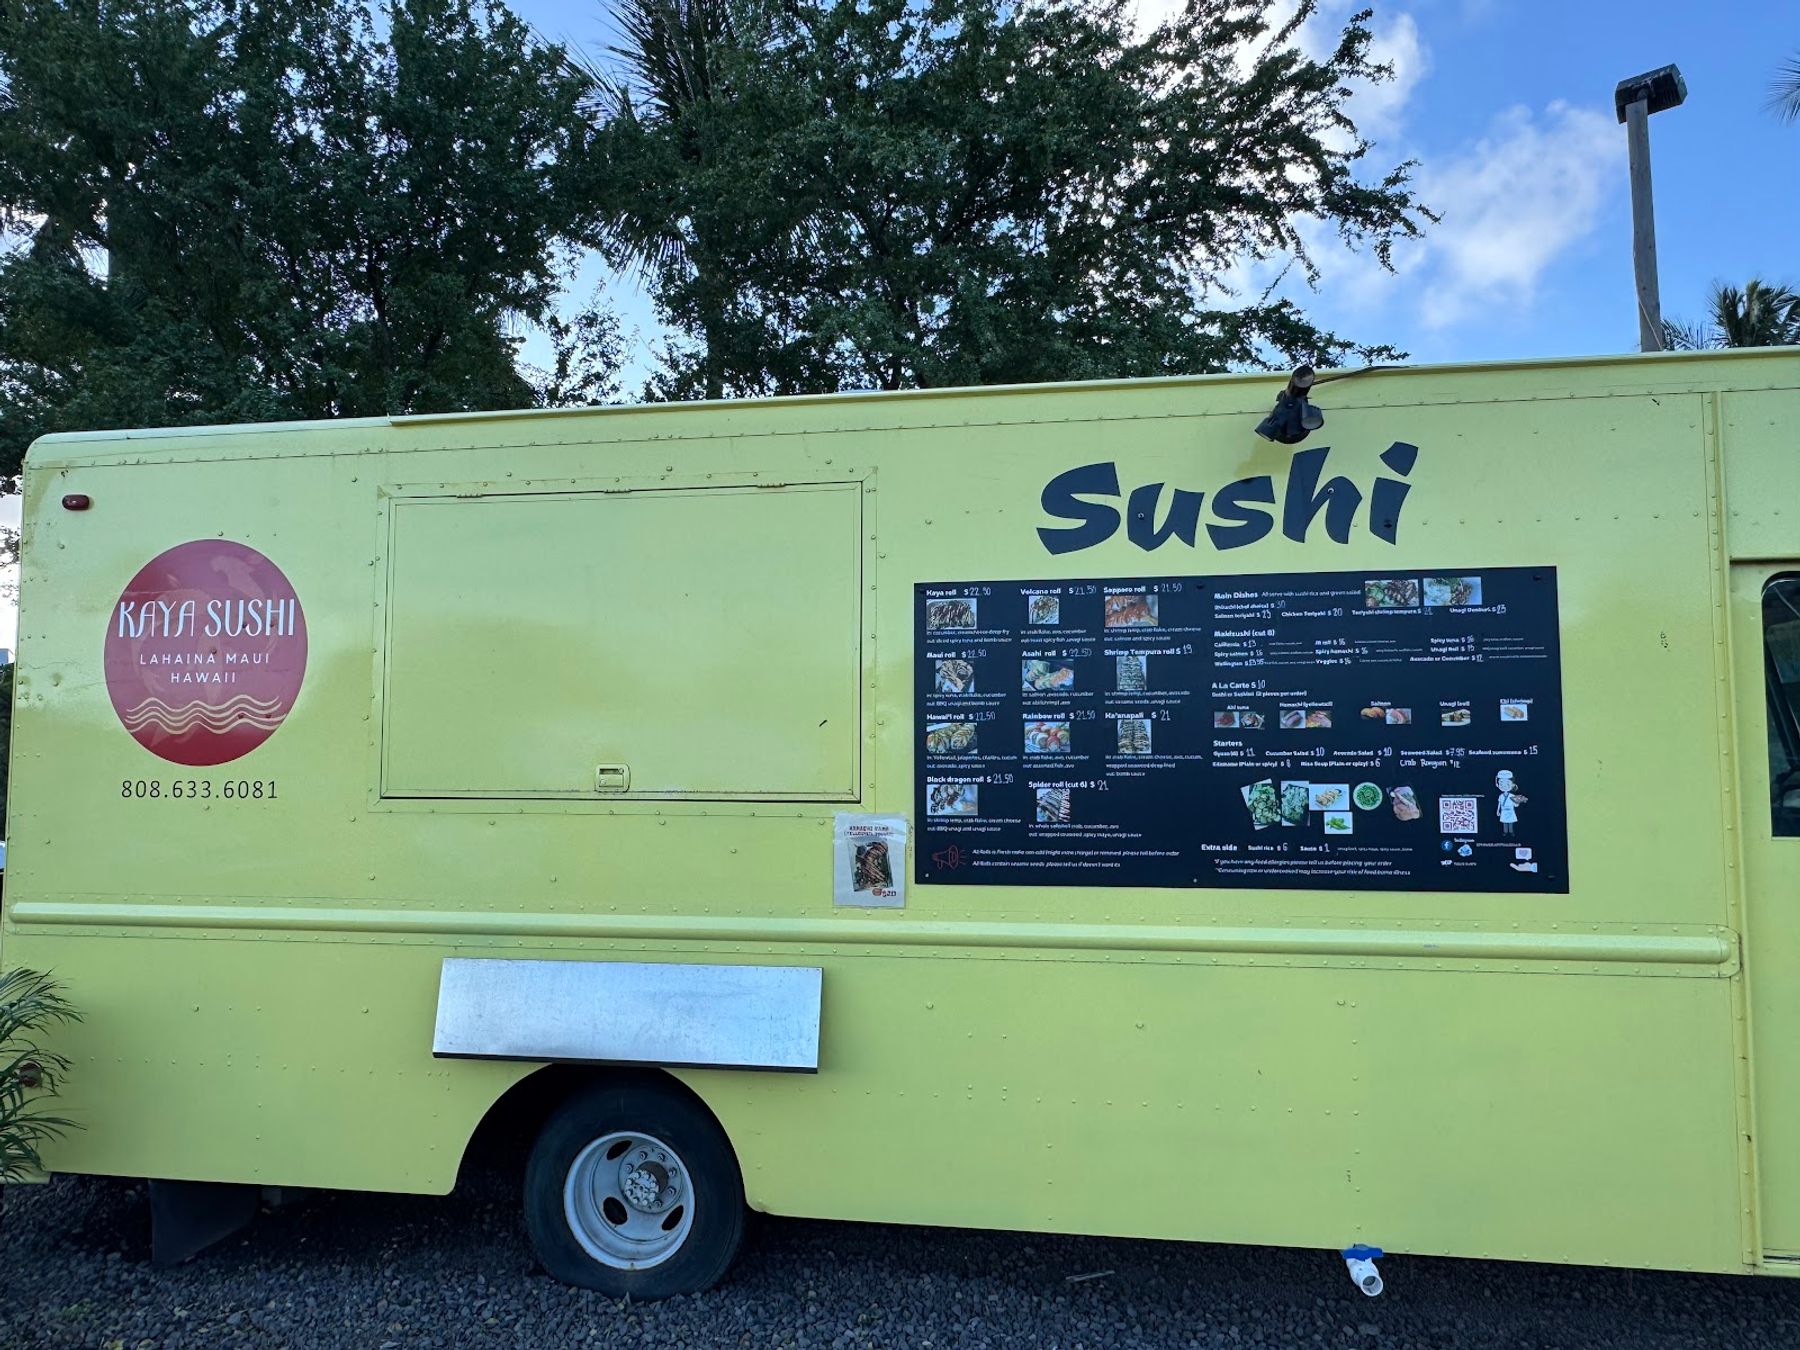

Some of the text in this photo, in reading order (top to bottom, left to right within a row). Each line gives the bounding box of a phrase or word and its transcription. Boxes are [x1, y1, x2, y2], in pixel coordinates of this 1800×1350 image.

[1036, 441, 1418, 555] Sushi
[926, 589, 944, 597] Kaya
[946, 589, 957, 597] roll
[1233, 591, 1259, 599] Dishes
[118, 598, 295, 638] KAYA SUSHI
[1130, 648, 1161, 656] Tempura
[1163, 647, 1174, 655] roll
[139, 653, 270, 665] LAHAINA MAUI
[170, 671, 237, 684] HAWAII
[948, 776, 971, 784] dragon
[1028, 781, 1051, 790] Spider
[1053, 780, 1064, 788] roll
[121, 779, 278, 799] 808.633.6081
[1201, 843, 1238, 851] Extra side
